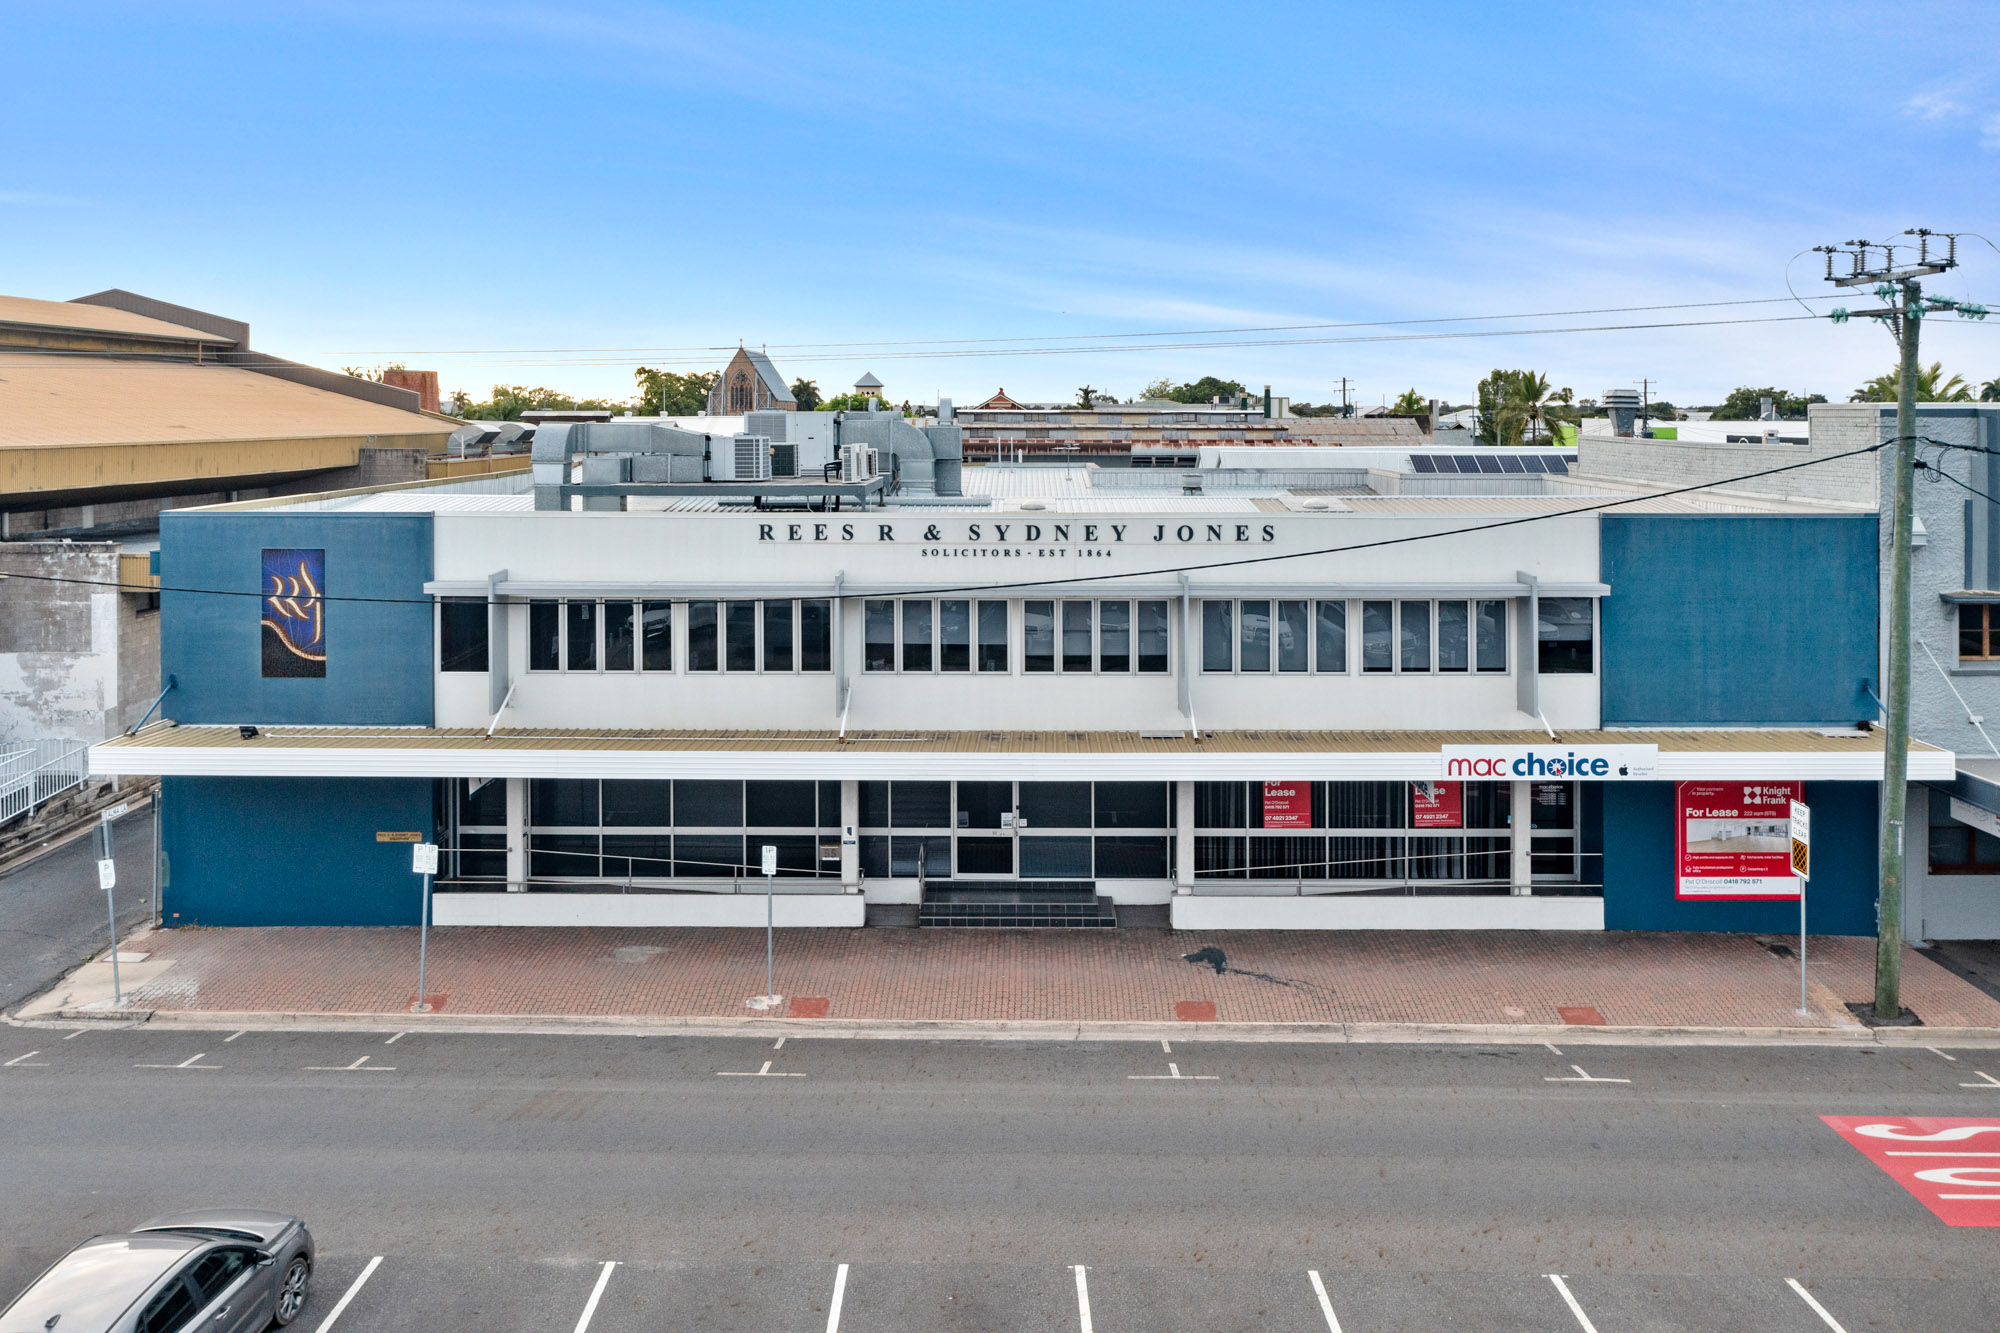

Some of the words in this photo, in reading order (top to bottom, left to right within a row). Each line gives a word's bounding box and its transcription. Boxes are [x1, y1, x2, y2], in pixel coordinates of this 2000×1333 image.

[758, 523, 854, 541] REES
[878, 524, 895, 541] R
[923, 524, 942, 541] &
[968, 524, 1127, 542] SYDNEY
[1153, 524, 1275, 542] JONES
[921, 549, 1021, 558] SOLICITORS
[1038, 549, 1067, 558] EST
[1077, 549, 1112, 558] 1864
[1448, 758, 1506, 776] mac
[1512, 752, 1609, 776] choice
[1265, 788, 1296, 797] Lease
[1415, 787, 1446, 796] Lse
[1763, 786, 1791, 796] Knight
[1763, 797, 1787, 805] Frank
[1686, 808, 1704, 817] For
[1706, 808, 1738, 817] Lease
[1794, 807, 1805, 816] KEEP
[1793, 827, 1807, 838] CLEAR
